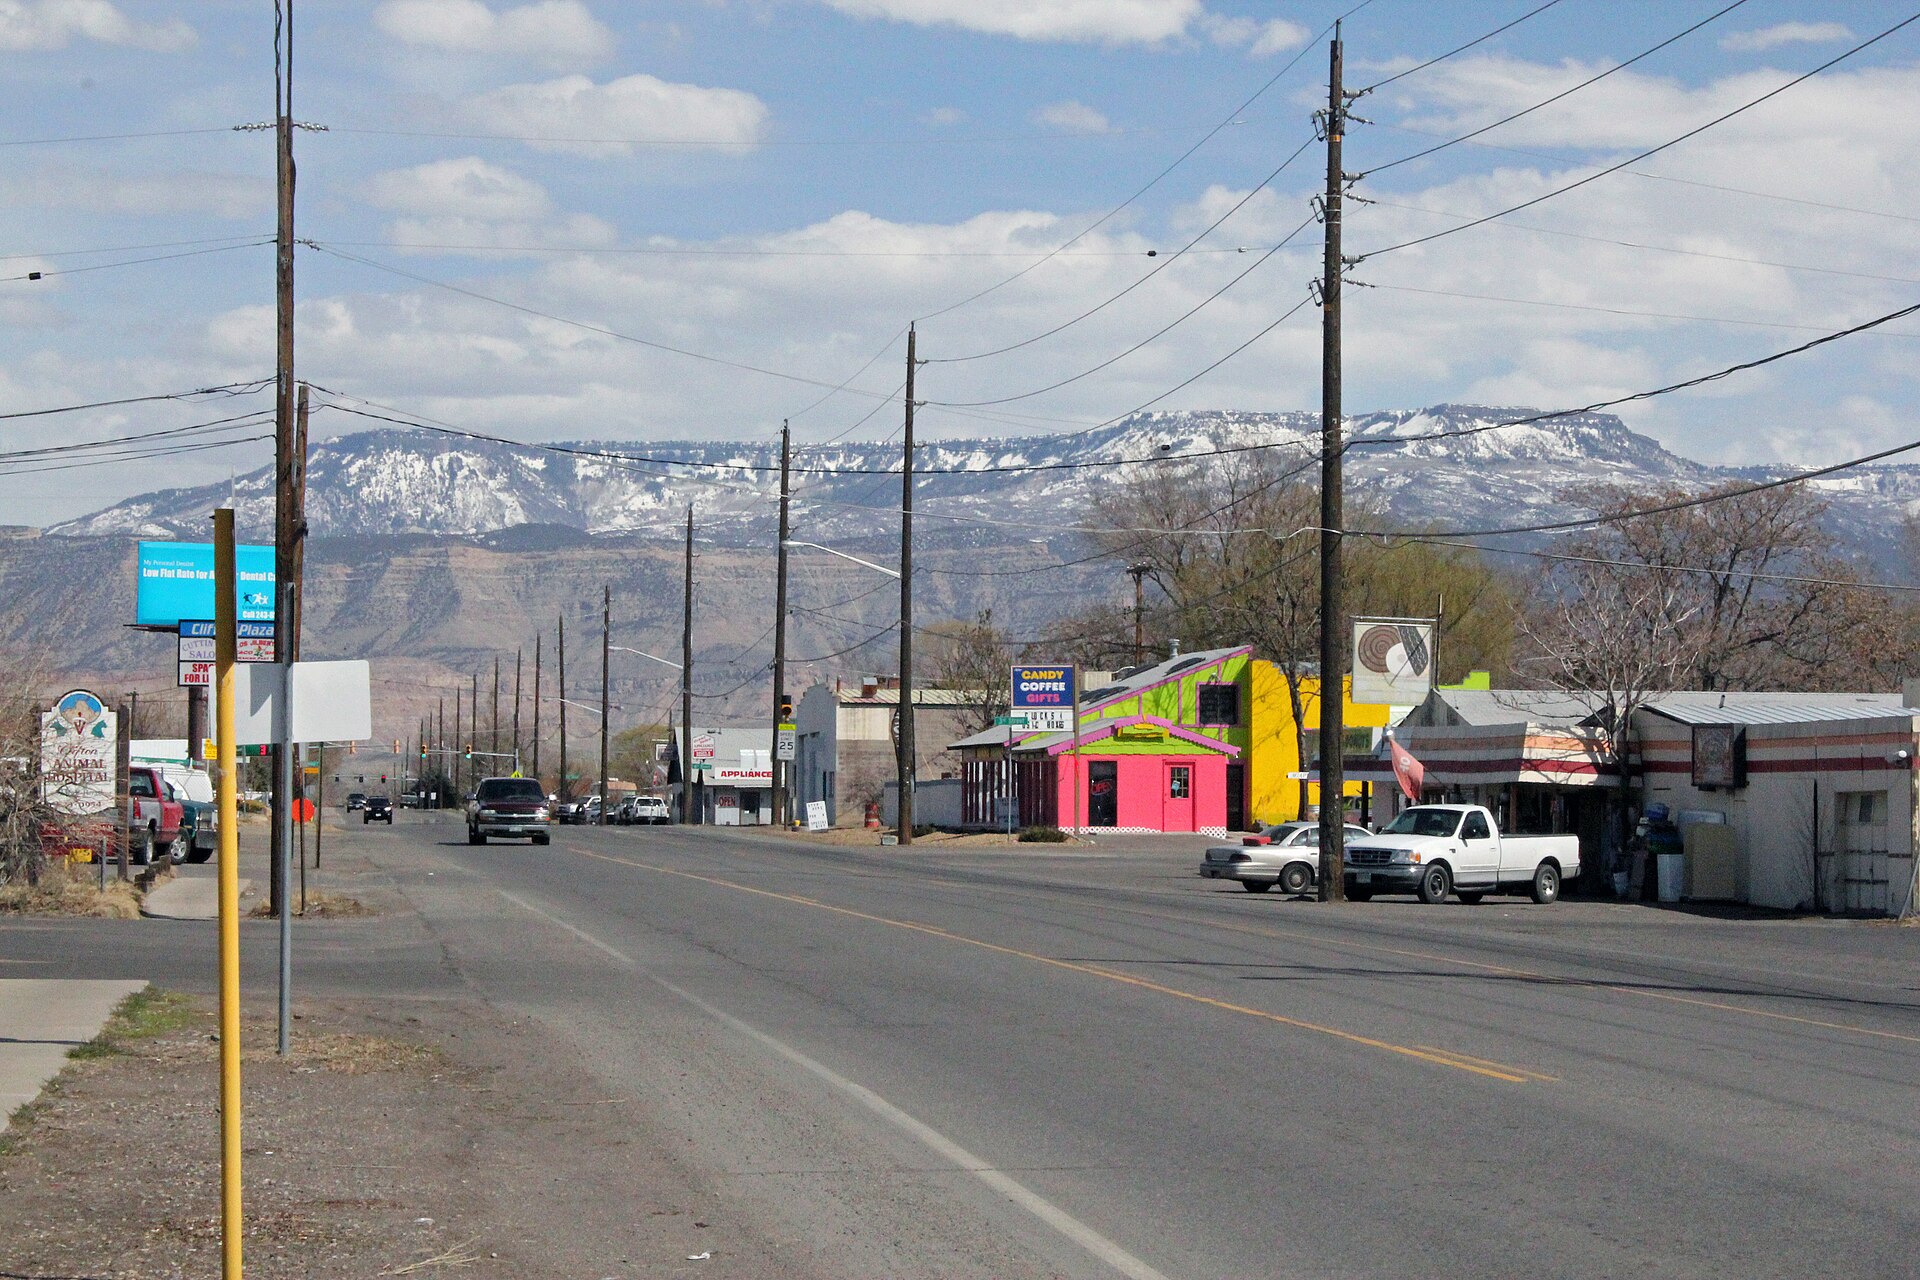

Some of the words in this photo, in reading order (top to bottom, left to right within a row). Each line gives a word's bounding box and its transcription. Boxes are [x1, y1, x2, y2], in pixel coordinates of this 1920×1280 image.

[143, 567, 159, 578] Low
[160, 568, 175, 579] Flat
[176, 568, 196, 579] Rate
[196, 569, 208, 580] for
[240, 571, 266, 582] Dental
[191, 623, 217, 635] Clif
[239, 624, 275, 636] Plaza
[189, 650, 215, 659] SALO
[192, 663, 209, 673] SPA
[184, 674, 201, 683] FOR
[1021, 671, 1064, 681] CANDY
[1019, 682, 1066, 692] COFFEE
[1026, 693, 1061, 703] GIFTS
[779, 741, 794, 751] 25
[54, 758, 106, 769] ANIMAL
[46, 771, 108, 782] HOSPITAL
[720, 770, 773, 778] APPLIANCE
[719, 796, 736, 807] OPEN
